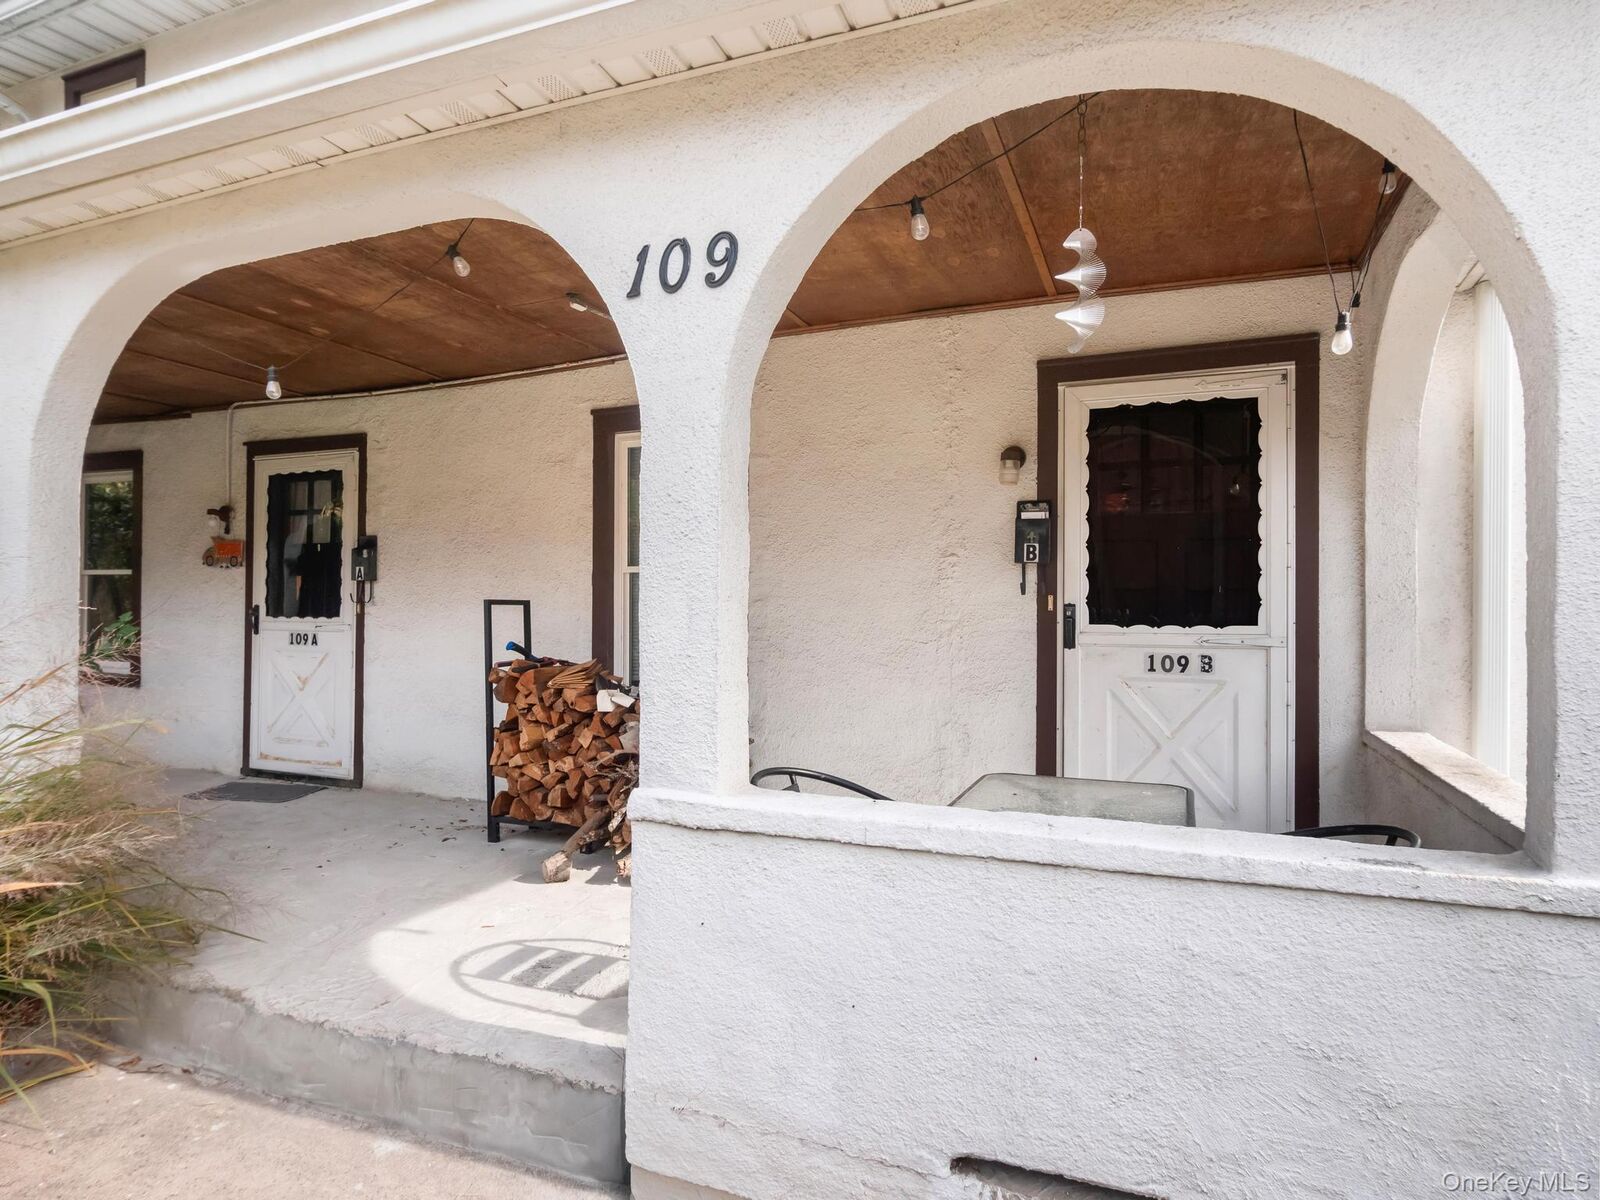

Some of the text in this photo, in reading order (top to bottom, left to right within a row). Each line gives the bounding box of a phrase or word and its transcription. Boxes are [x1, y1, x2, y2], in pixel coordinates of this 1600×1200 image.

[626, 230, 739, 299] 109
[1025, 544, 1038, 561] B
[356, 567, 363, 580] A
